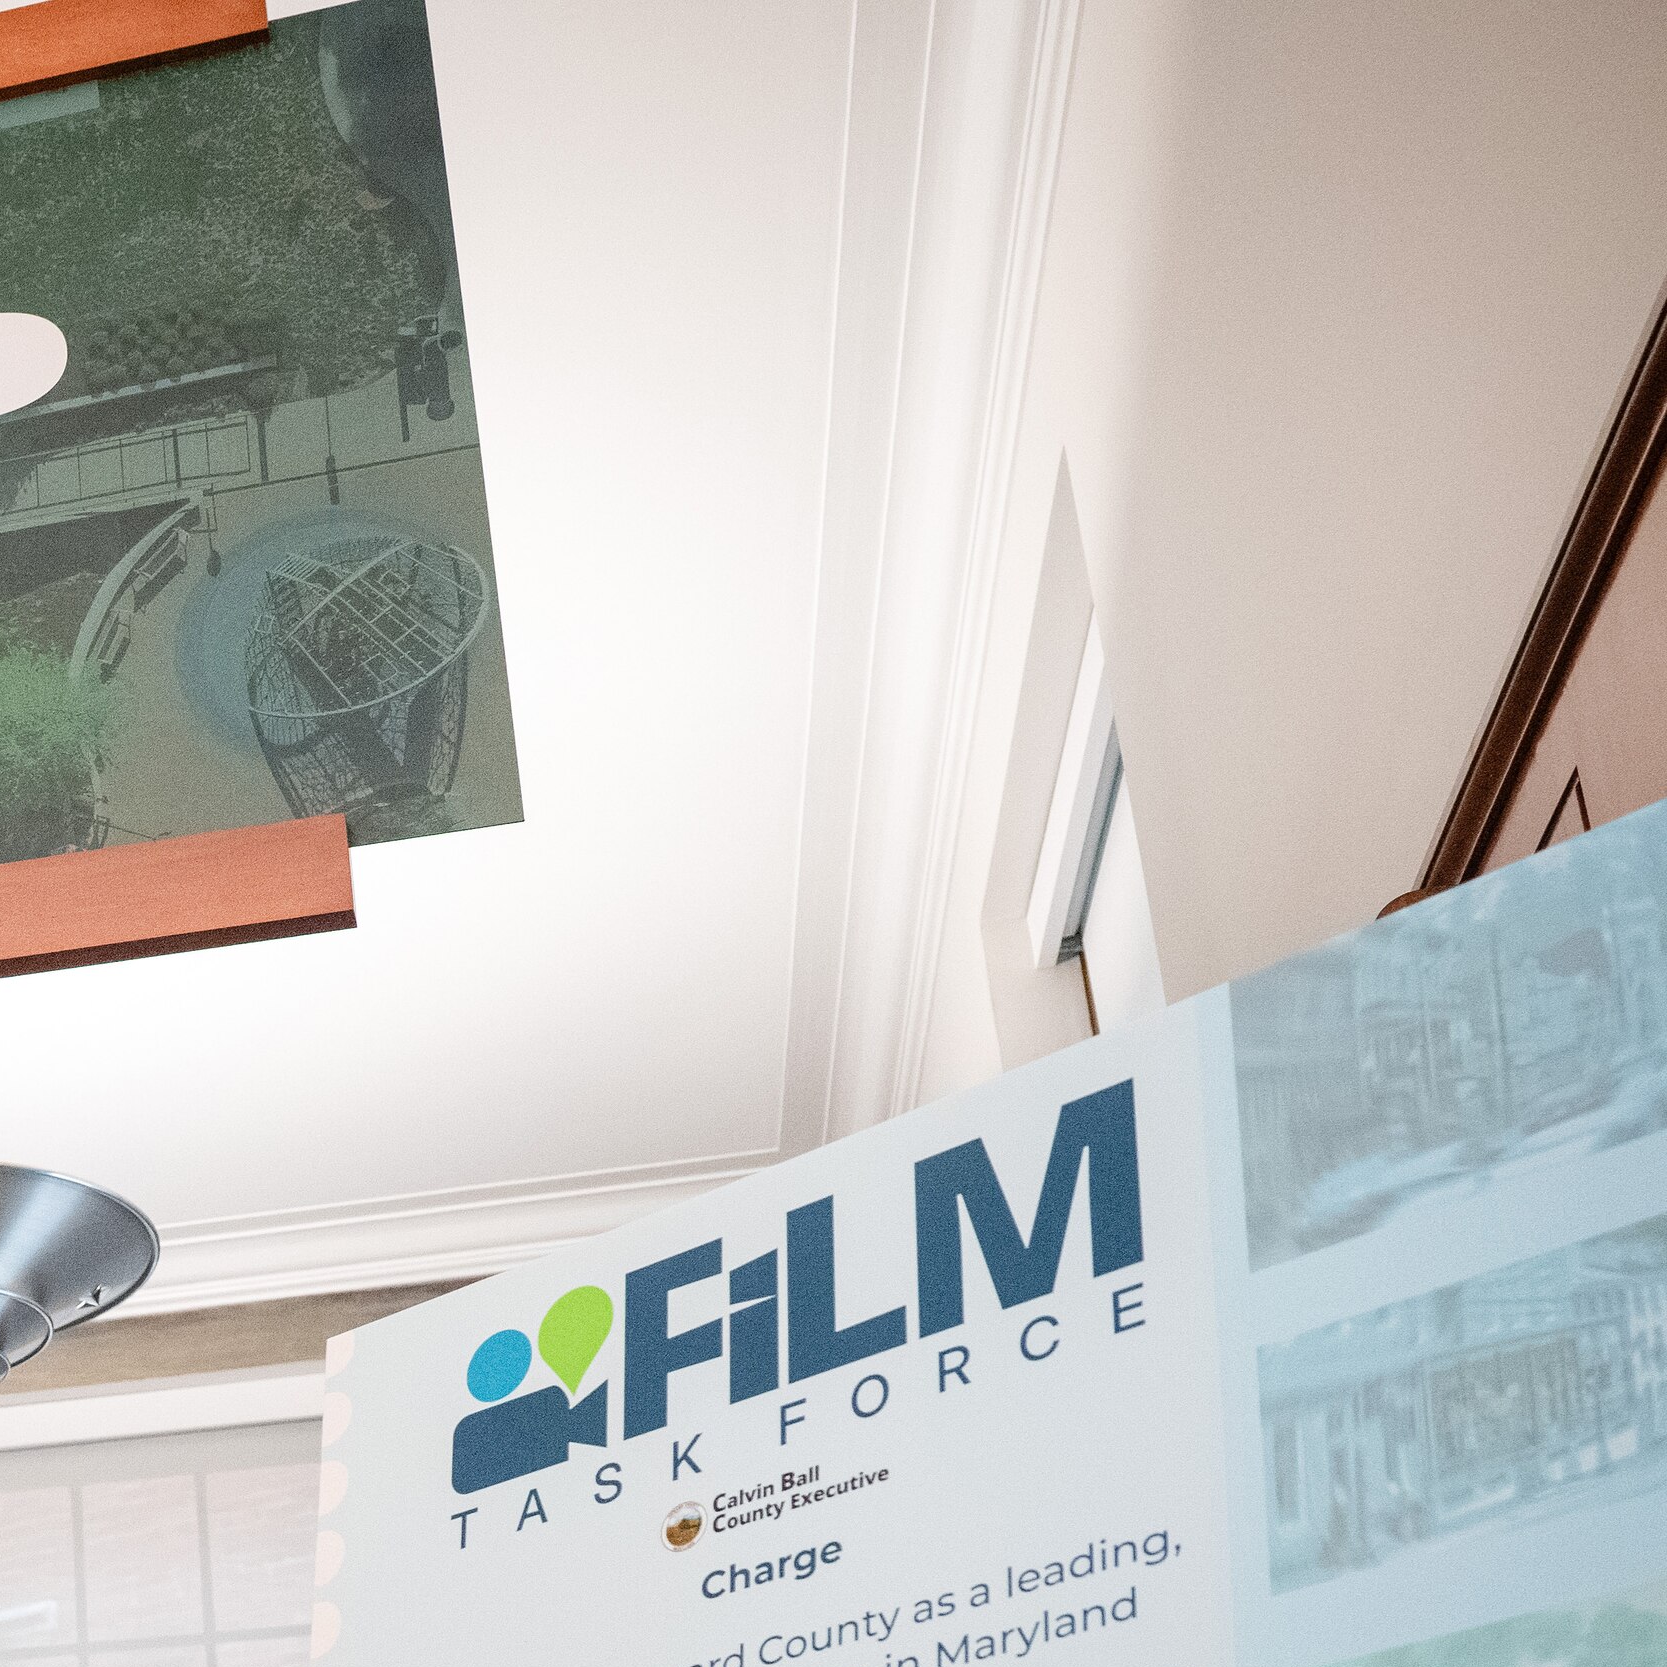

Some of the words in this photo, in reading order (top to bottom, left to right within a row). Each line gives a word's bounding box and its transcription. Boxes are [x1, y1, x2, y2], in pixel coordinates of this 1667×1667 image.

[449, 1432, 703, 1551] TASK
[779, 1281, 1147, 1447] FORCE
[711, 1482, 776, 1514] Calvin
[780, 1464, 821, 1493] Ball
[711, 1500, 786, 1535] County
[789, 1467, 890, 1511] Executive
[700, 1540, 844, 1601] Charge
[757, 1606, 901, 1667] County
[912, 1591, 957, 1625] as
[968, 1581, 991, 1609] a
[1006, 1529, 1183, 1599] leading,
